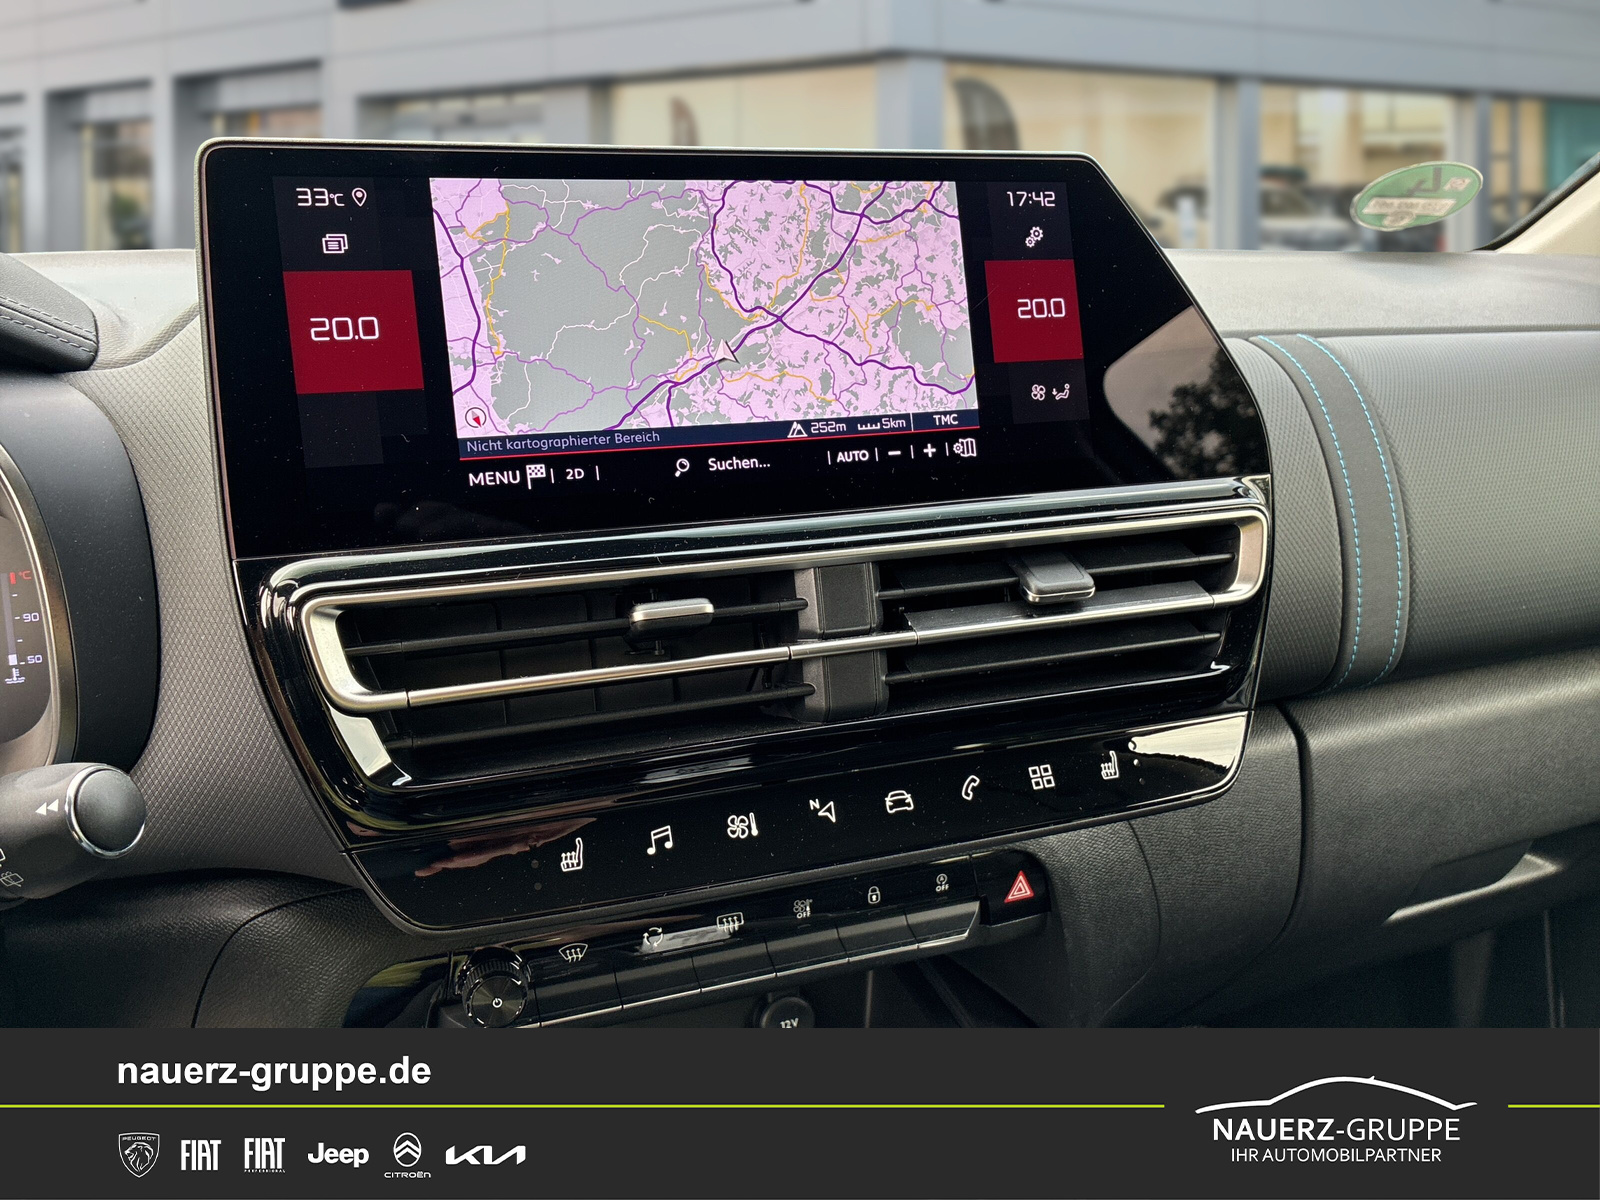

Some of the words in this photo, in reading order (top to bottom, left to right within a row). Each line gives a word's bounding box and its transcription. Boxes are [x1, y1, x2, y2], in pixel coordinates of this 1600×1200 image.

[1006, 191, 1056, 207] 17:42
[1017, 298, 1066, 318] 20.0
[309, 316, 380, 341] 20.0
[881, 417, 906, 429] 5km
[933, 413, 959, 426] TMC
[810, 421, 847, 434] 252m
[466, 439, 503, 453] Nicht
[505, 434, 612, 452] kartographierter
[613, 430, 661, 445] Bereich
[836, 450, 870, 463] AUTO
[707, 457, 771, 472] Suchen...
[468, 470, 522, 487] MENU
[565, 467, 585, 480] 2D
[22, 612, 40, 622] 90
[27, 654, 43, 665] 50
[935, 883, 950, 893] OFF
[796, 911, 812, 919] OFF
[780, 1017, 799, 1029] 12V
